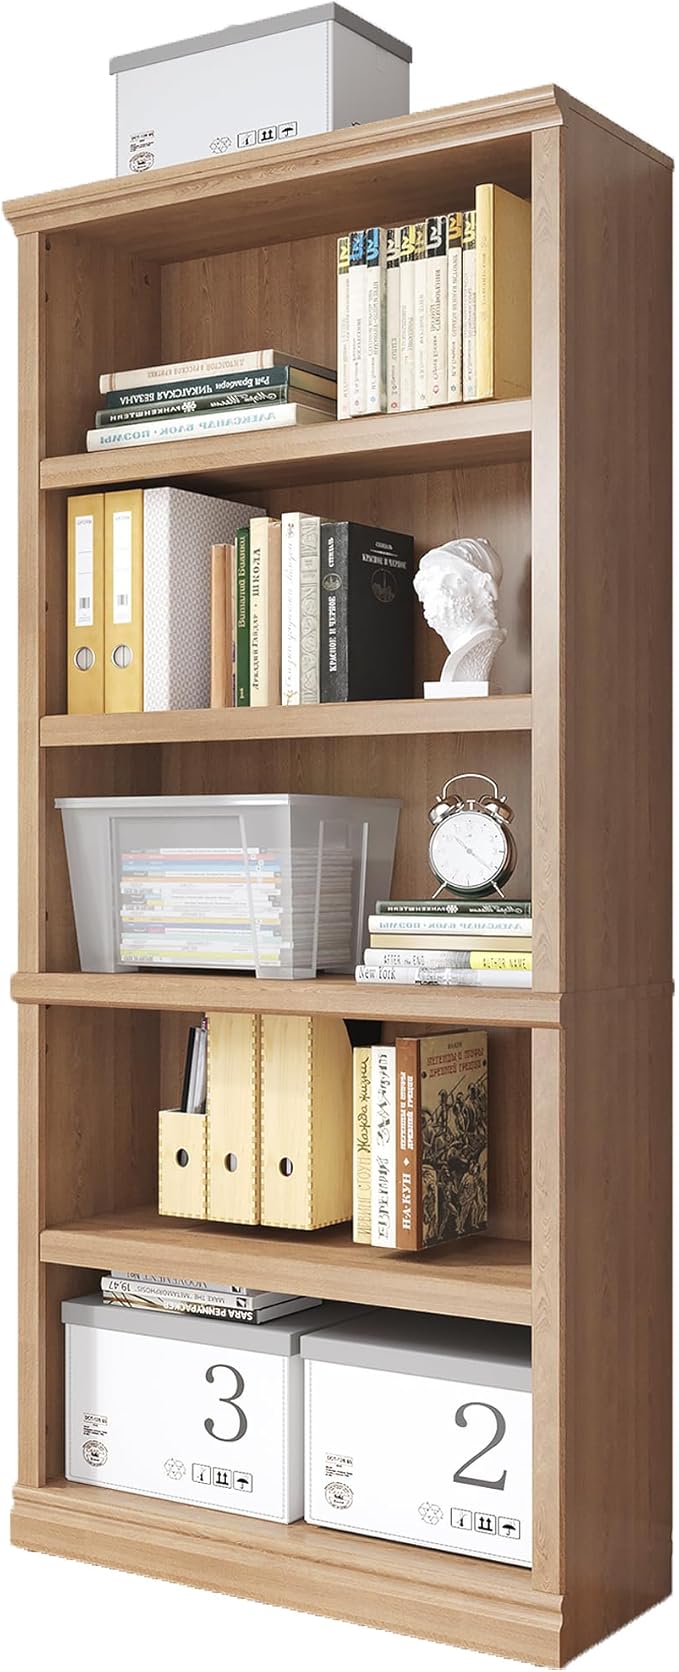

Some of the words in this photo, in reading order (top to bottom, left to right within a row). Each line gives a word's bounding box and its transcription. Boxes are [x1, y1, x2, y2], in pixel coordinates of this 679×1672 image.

[159, 384, 213, 400] ЧИКАГСКАЯ
[238, 536, 246, 576] Бианки
[252, 548, 261, 596] ШКОЛА
[238, 579, 246, 627] Виталий
[328, 637, 337, 672] КРАСНОЕ
[358, 967, 376, 979] New
[378, 965, 396, 980] York
[358, 1056, 370, 1102] жизни
[357, 1106, 370, 1153] Жажда
[108, 1280, 131, 1292] 19,47
[163, 1302, 226, 1318] PENNYPACKER
[227, 1308, 253, 1321] SARA
[204, 1363, 248, 1442] 3
[453, 1401, 507, 1491] 2
